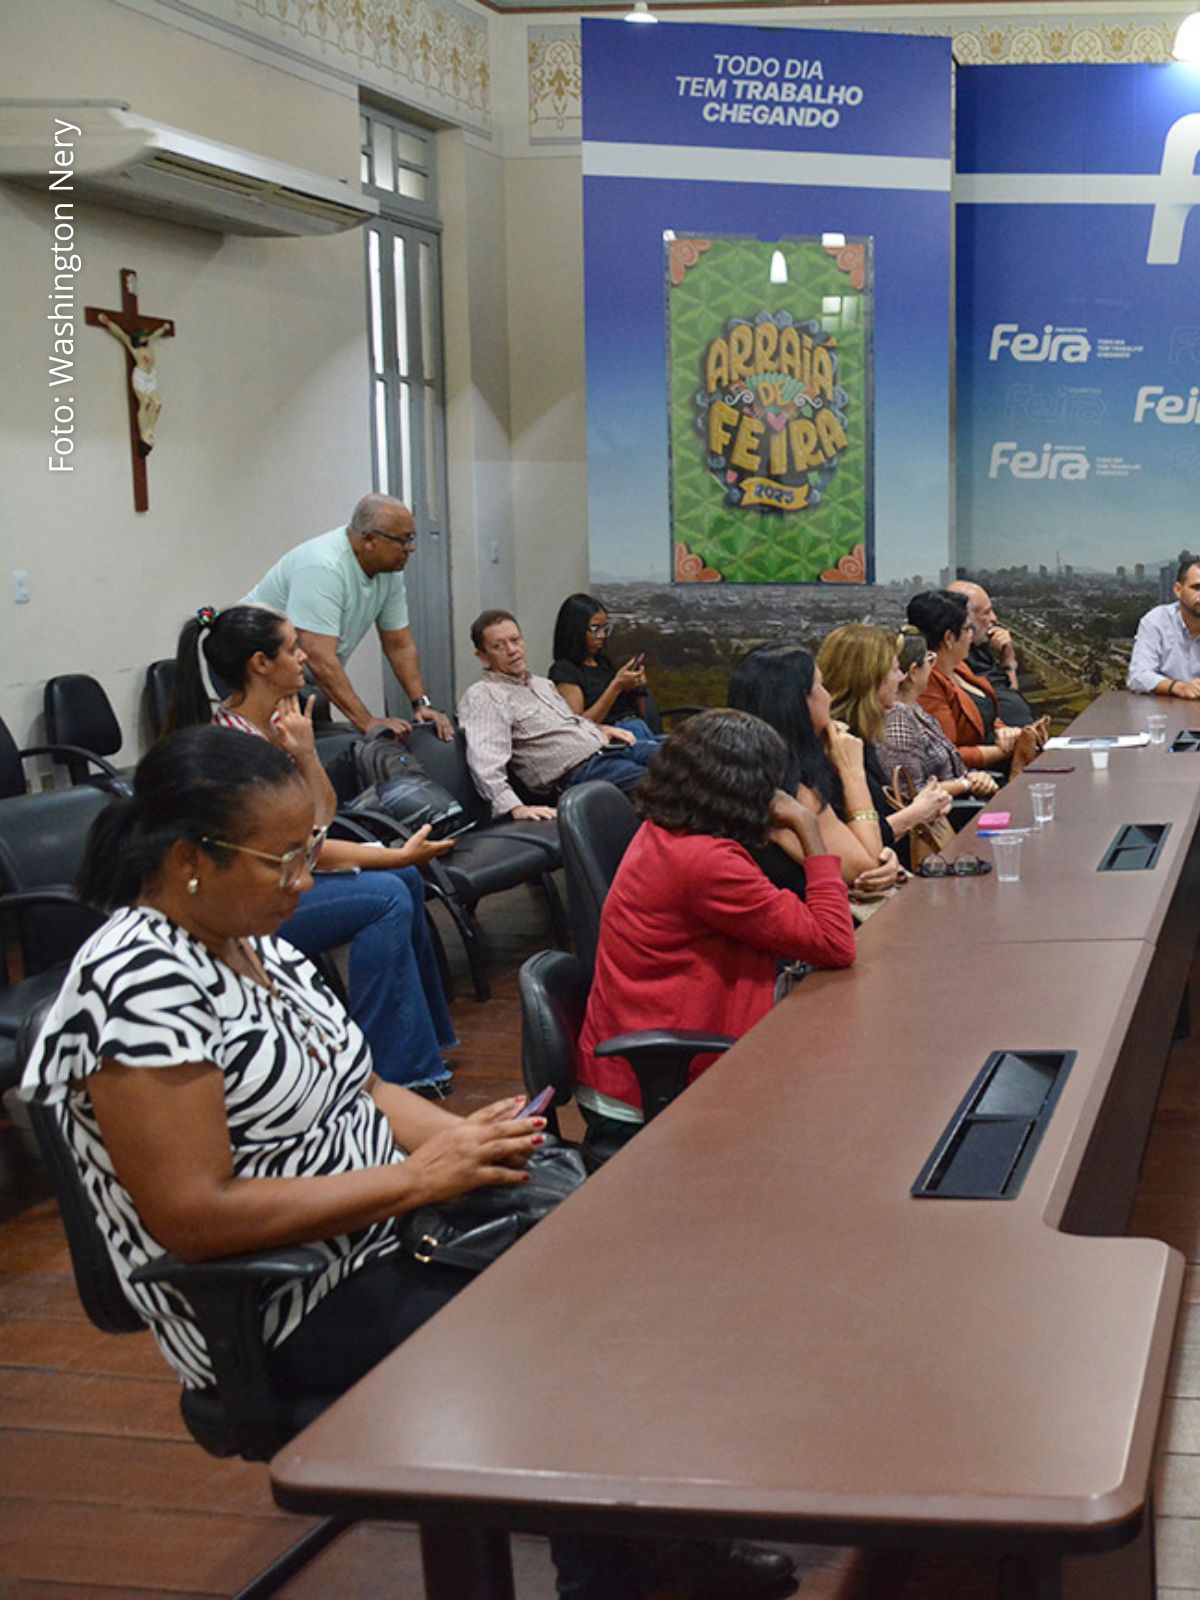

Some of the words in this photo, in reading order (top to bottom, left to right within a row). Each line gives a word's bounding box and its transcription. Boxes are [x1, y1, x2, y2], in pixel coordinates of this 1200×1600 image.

[713, 54, 780, 78] TODO
[784, 58, 824, 80] DIA
[676, 76, 726, 99] TEM
[732, 79, 863, 106] TRABALHO
[702, 101, 840, 129] CHEGANDO
[756, 381, 787, 407] DE
[709, 400, 848, 475] FEIRA
[754, 485, 795, 502] 2025
